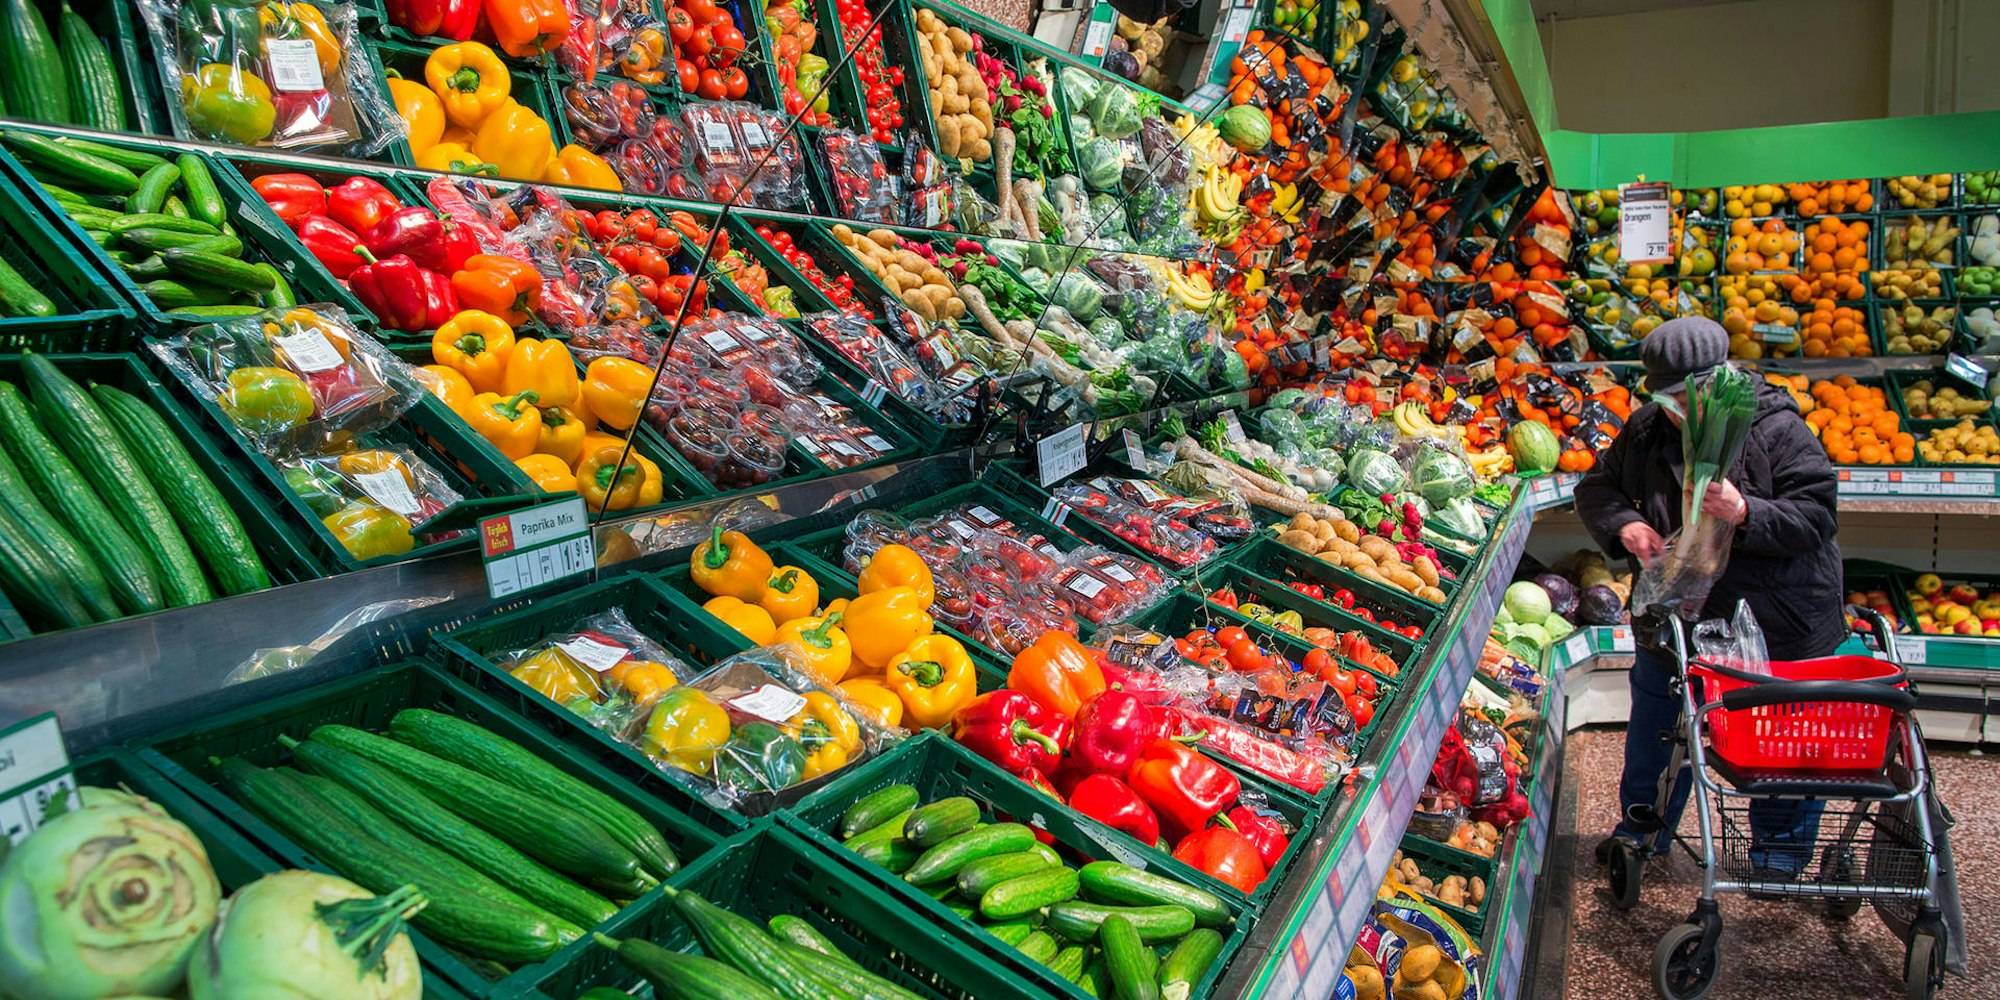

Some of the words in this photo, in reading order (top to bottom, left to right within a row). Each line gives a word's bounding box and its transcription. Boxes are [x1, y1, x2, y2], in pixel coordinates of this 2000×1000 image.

[1624, 214, 1652, 222] Orangen
[521, 518, 556, 536] Paprika
[557, 513, 574, 525] Mix
